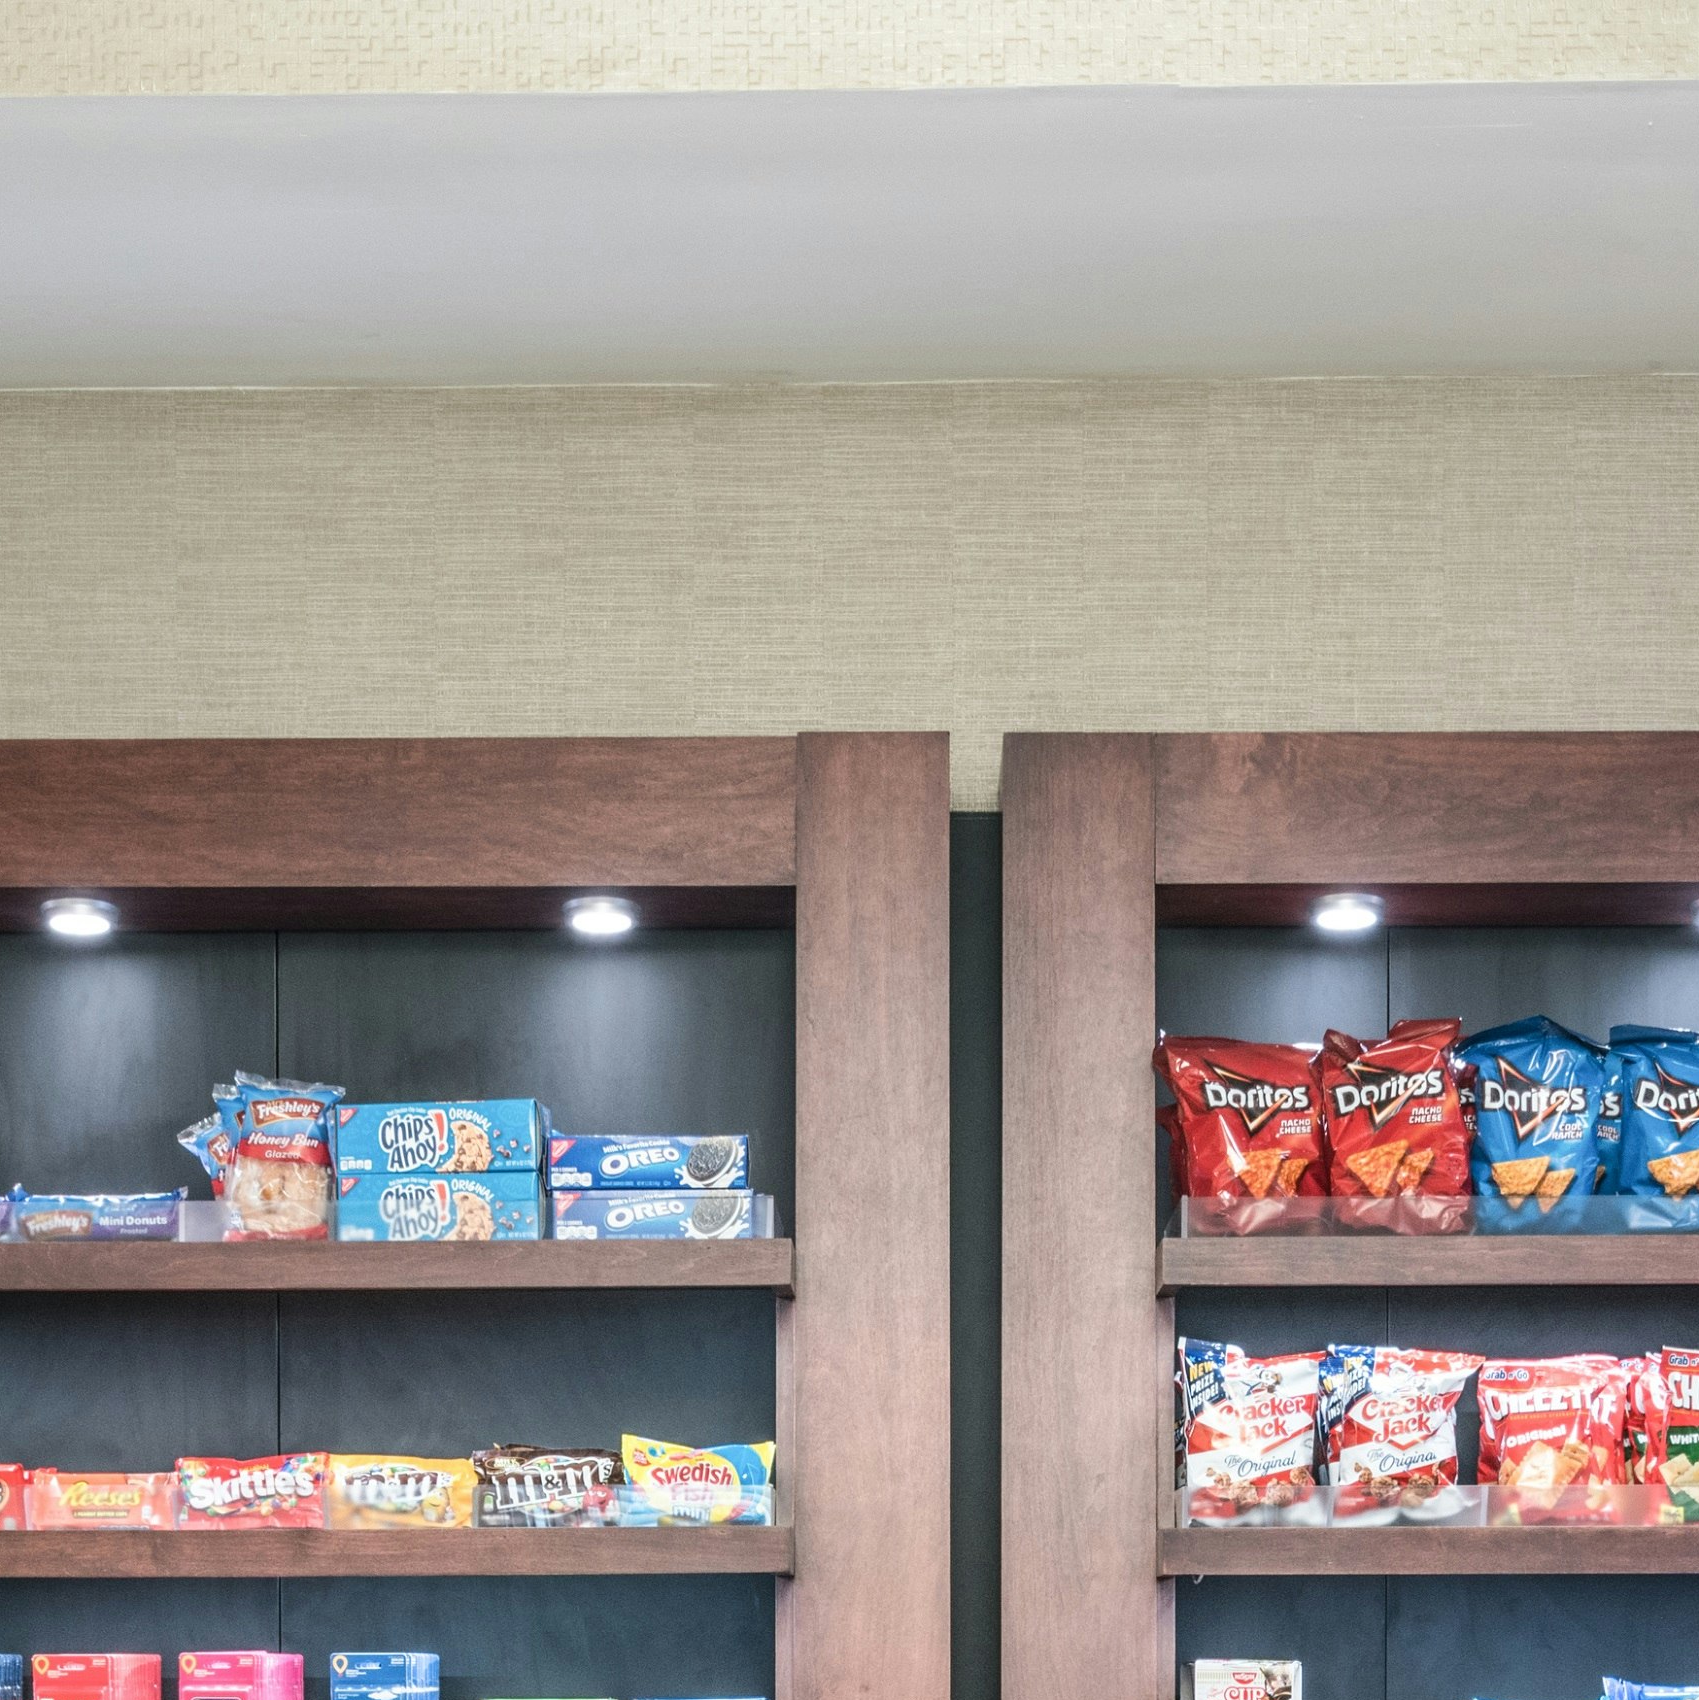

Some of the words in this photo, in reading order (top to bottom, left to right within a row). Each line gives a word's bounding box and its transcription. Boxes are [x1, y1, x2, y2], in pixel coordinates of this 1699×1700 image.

[1204, 1081, 1310, 1109] Doritos
[1335, 1068, 1444, 1115] Doritos
[1483, 1080, 1587, 1113] Doritos
[257, 1099, 321, 1119] Freshley's
[449, 1107, 493, 1131] ORIGINAL
[1409, 1113, 1443, 1125] CHEESE
[1411, 1105, 1443, 1116] NACHO
[380, 1114, 434, 1151] Chips
[1280, 1118, 1311, 1127] NACHO
[1280, 1125, 1312, 1134] CHEESE
[1559, 1122, 1583, 1132] COOL
[248, 1131, 290, 1148] Honey
[292, 1136, 319, 1149] Bun
[1552, 1130, 1583, 1140] RANCH
[264, 1150, 299, 1159] Glazed
[601, 1146, 680, 1176] OREO
[451, 1179, 495, 1201] ORIGINAL
[383, 1186, 437, 1220] Chips
[606, 1200, 685, 1228] OREO
[26, 1213, 89, 1236] Freshley's
[99, 1215, 124, 1226] Mini
[127, 1215, 168, 1226] Donuts
[1189, 1361, 1214, 1381] NEW
[1668, 1354, 1689, 1367] Grab
[1190, 1374, 1216, 1395] PRIZE
[1373, 1412, 1432, 1443] Jack
[1224, 1454, 1243, 1468] The
[1237, 1450, 1297, 1478] Original
[1366, 1448, 1384, 1461] The
[1379, 1450, 1437, 1472] Original
[651, 1463, 733, 1486] Swedish
[189, 1468, 315, 1509] Skittles
